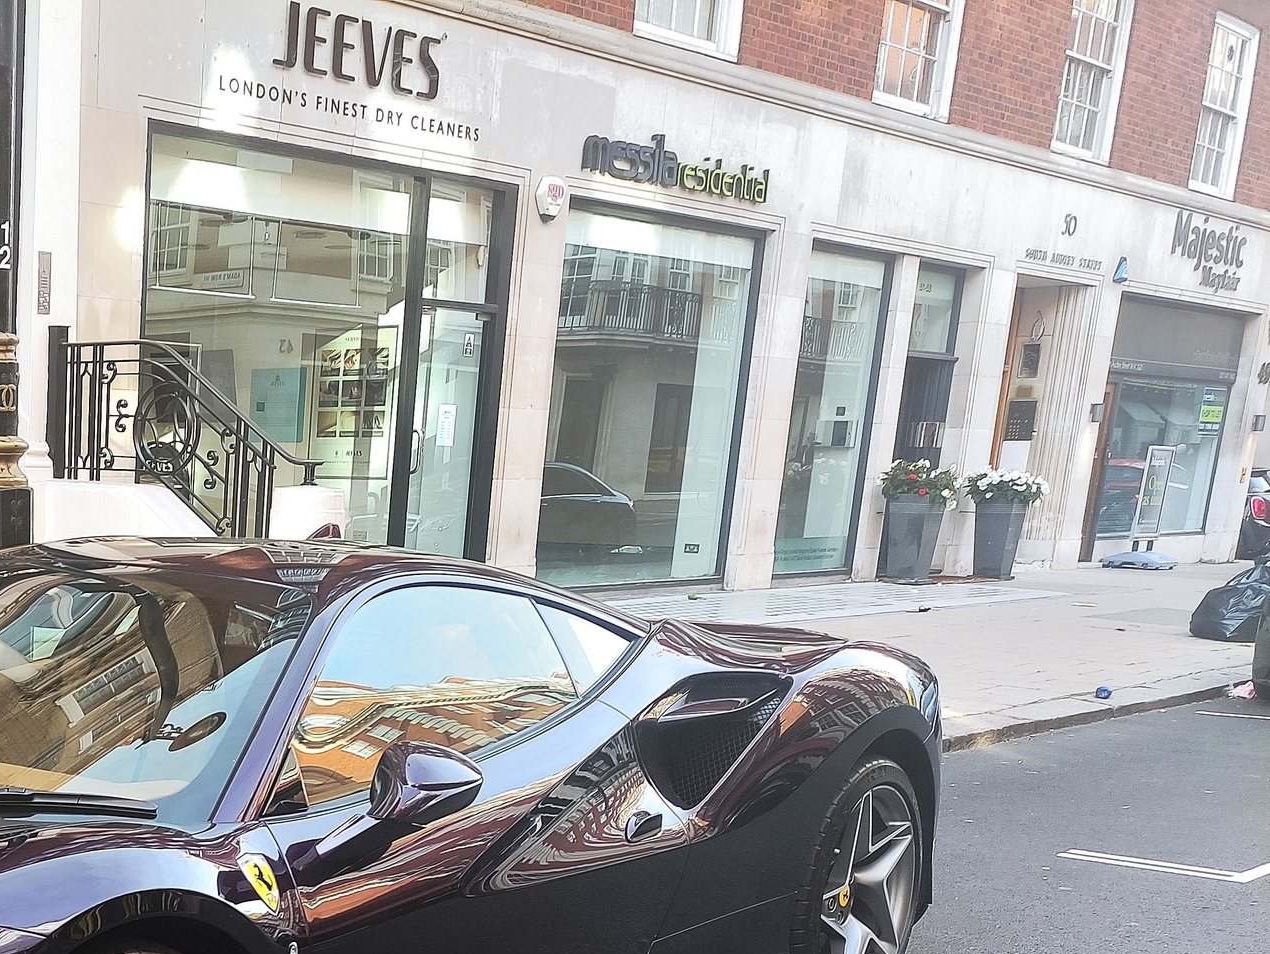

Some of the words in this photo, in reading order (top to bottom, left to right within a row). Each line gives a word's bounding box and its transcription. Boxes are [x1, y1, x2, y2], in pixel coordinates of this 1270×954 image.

[272, 0, 441, 100] JEEVES
[219, 75, 307, 107] LONDON'S
[316, 96, 367, 119] FINEST
[376, 108, 402, 127] DRY
[411, 115, 480, 142] CLEANERS
[580, 134, 678, 188] messila
[677, 157, 771, 204] residential
[1170, 209, 1247, 272] Majestic
[1199, 265, 1241, 293] Mayfair
